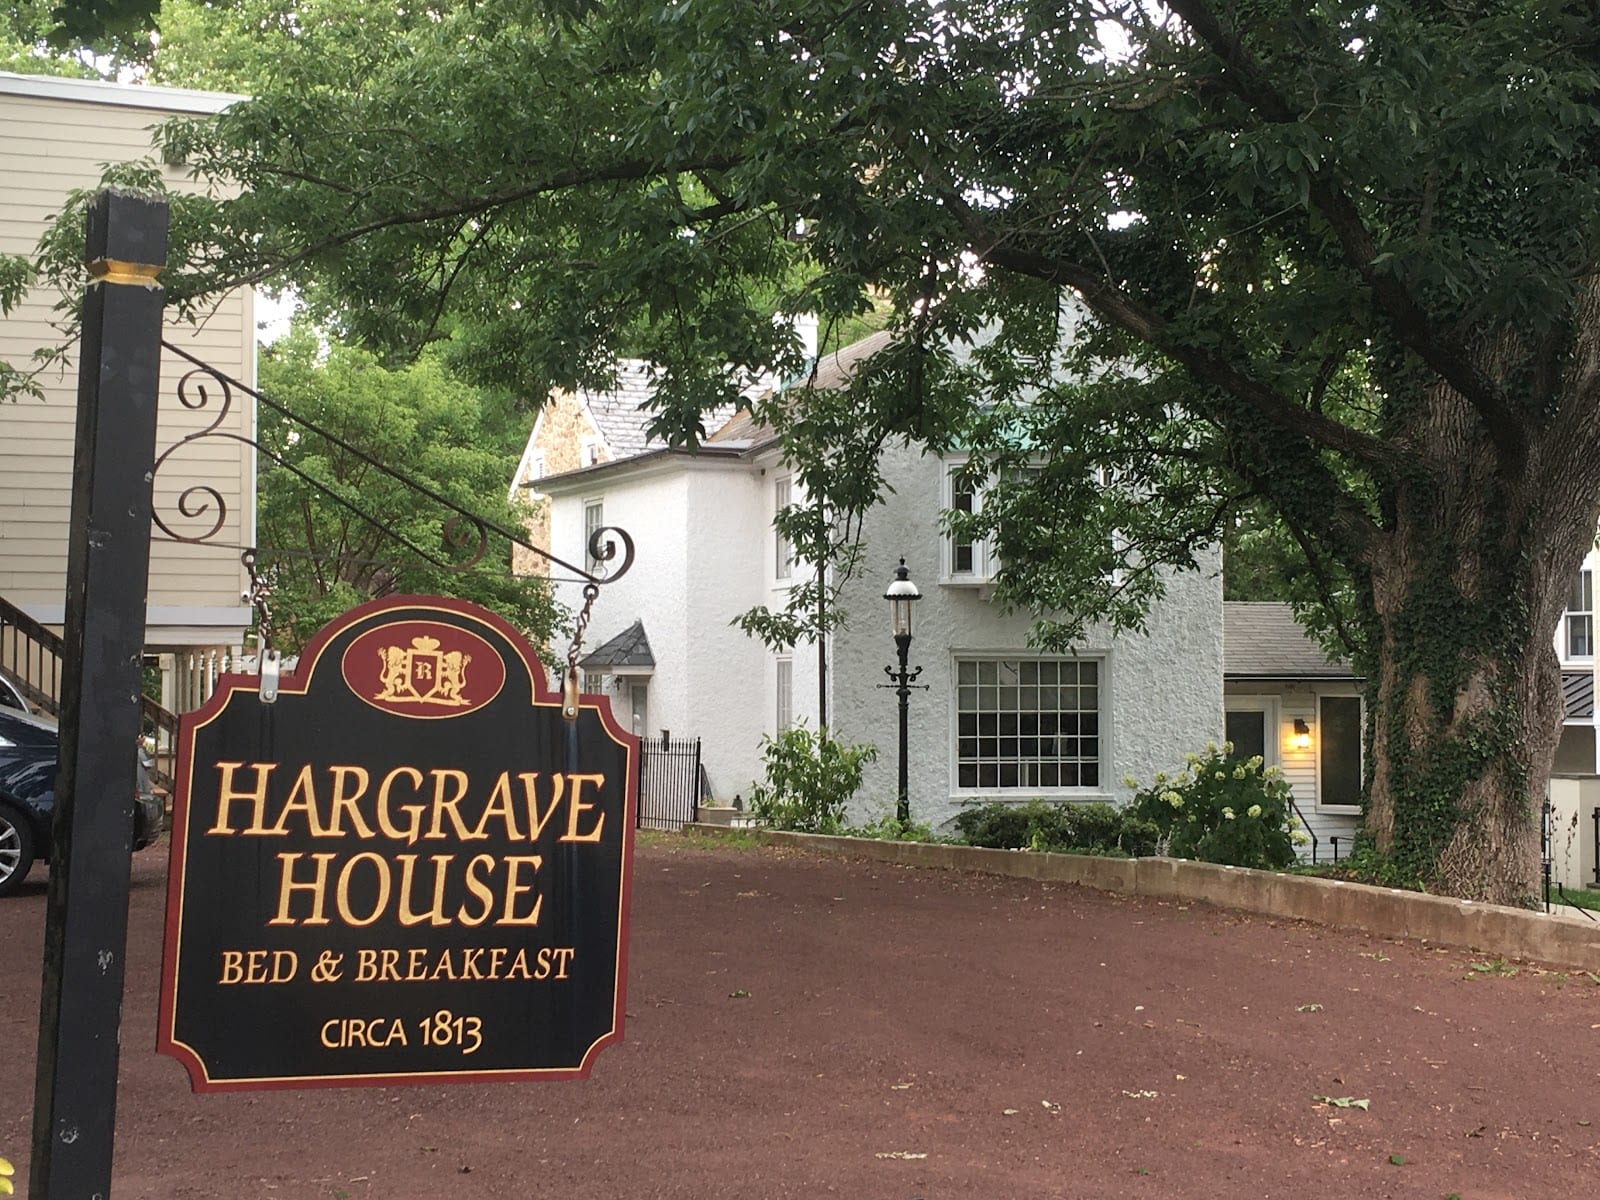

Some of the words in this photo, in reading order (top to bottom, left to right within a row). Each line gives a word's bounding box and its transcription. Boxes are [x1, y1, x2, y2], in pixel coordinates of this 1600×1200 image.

[415, 661, 433, 680] R
[206, 761, 607, 847] HARGRAVE
[268, 852, 543, 927] HOUSE
[219, 950, 298, 984] BED
[311, 949, 344, 983] &
[354, 948, 575, 982] BREAKFAST
[320, 1018, 408, 1048] CIRCA
[419, 1009, 483, 1055] 1813
